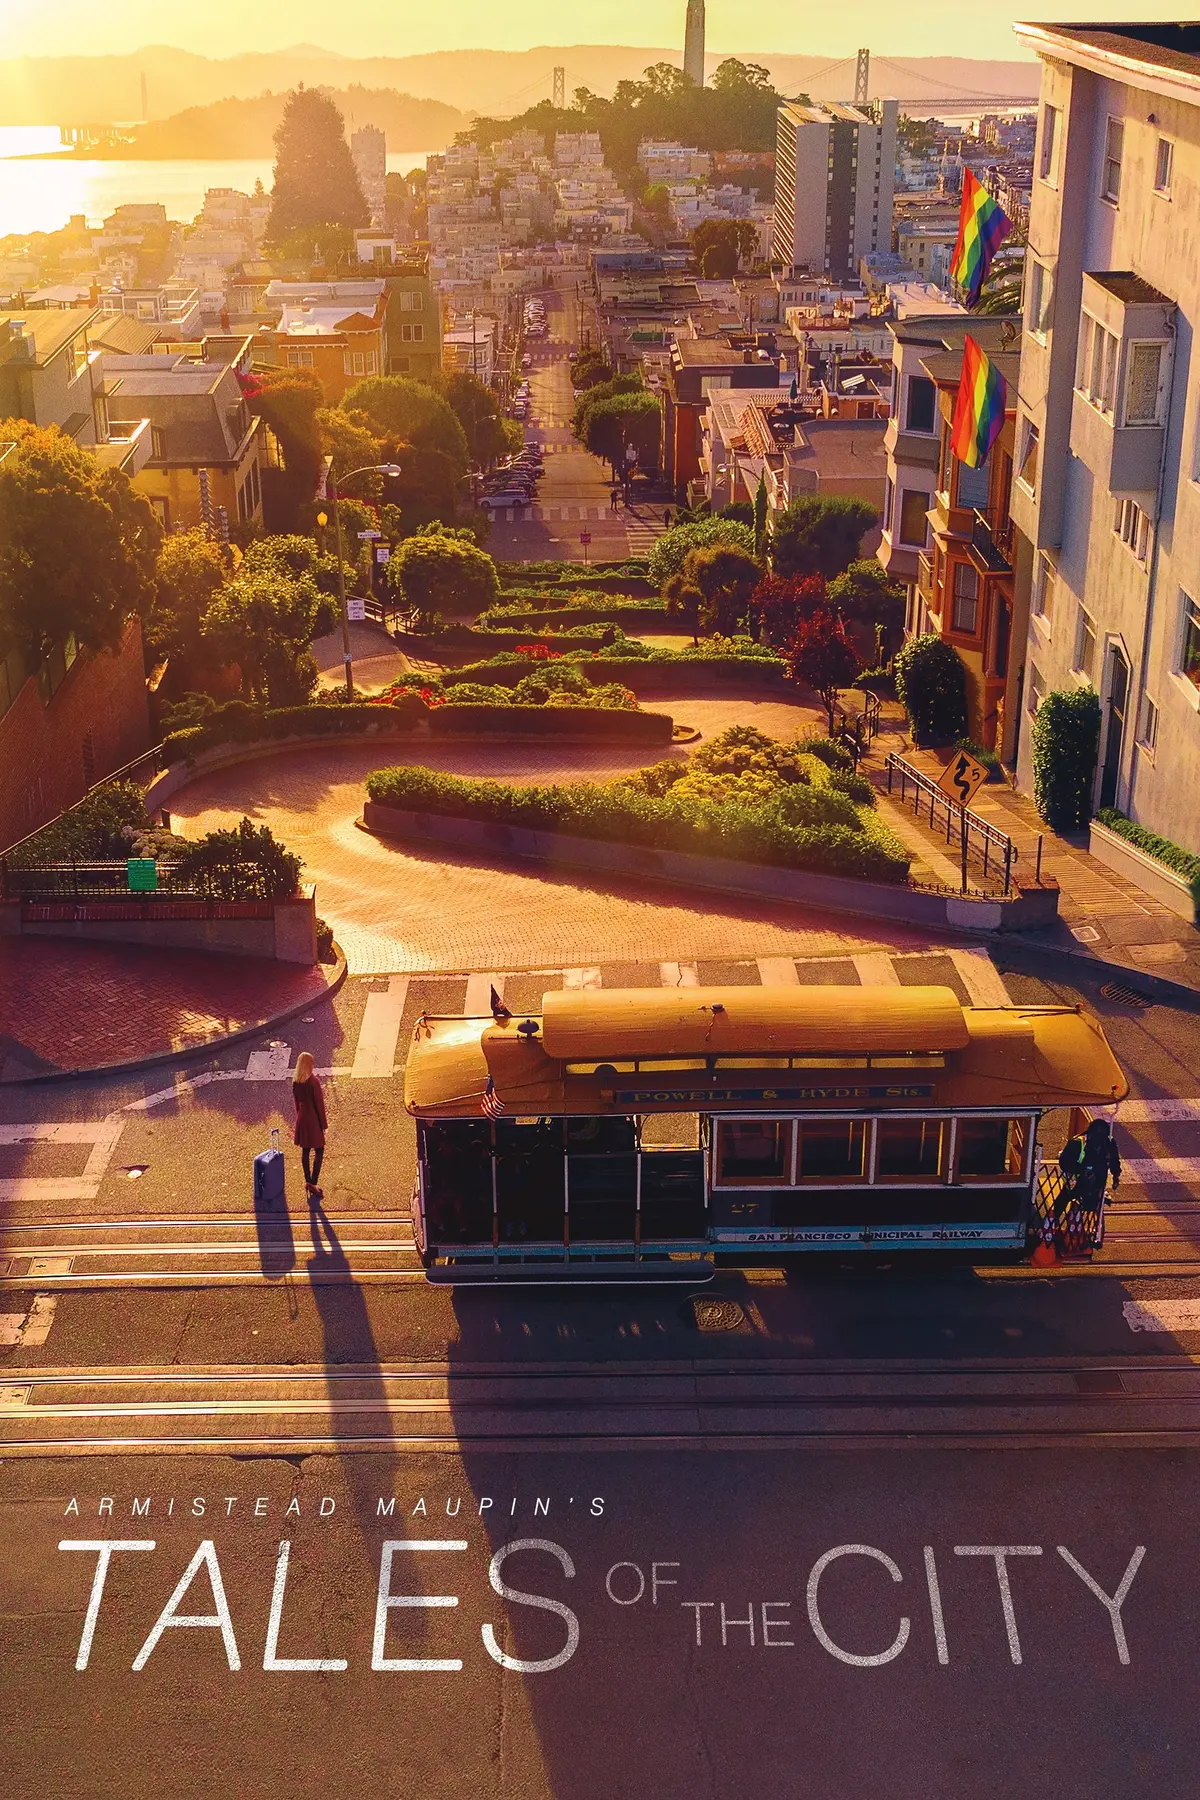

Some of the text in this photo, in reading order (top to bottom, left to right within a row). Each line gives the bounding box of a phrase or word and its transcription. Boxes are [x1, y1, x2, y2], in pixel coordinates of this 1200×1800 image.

[971, 768, 980, 781] 5
[633, 1086, 923, 1102] POWELL & HYDE Sts.
[731, 1203, 759, 1213] 27
[747, 1233, 775, 1241] SAN
[858, 1230, 924, 1240] MNICIPAL
[932, 1230, 984, 1239] RAILWAY
